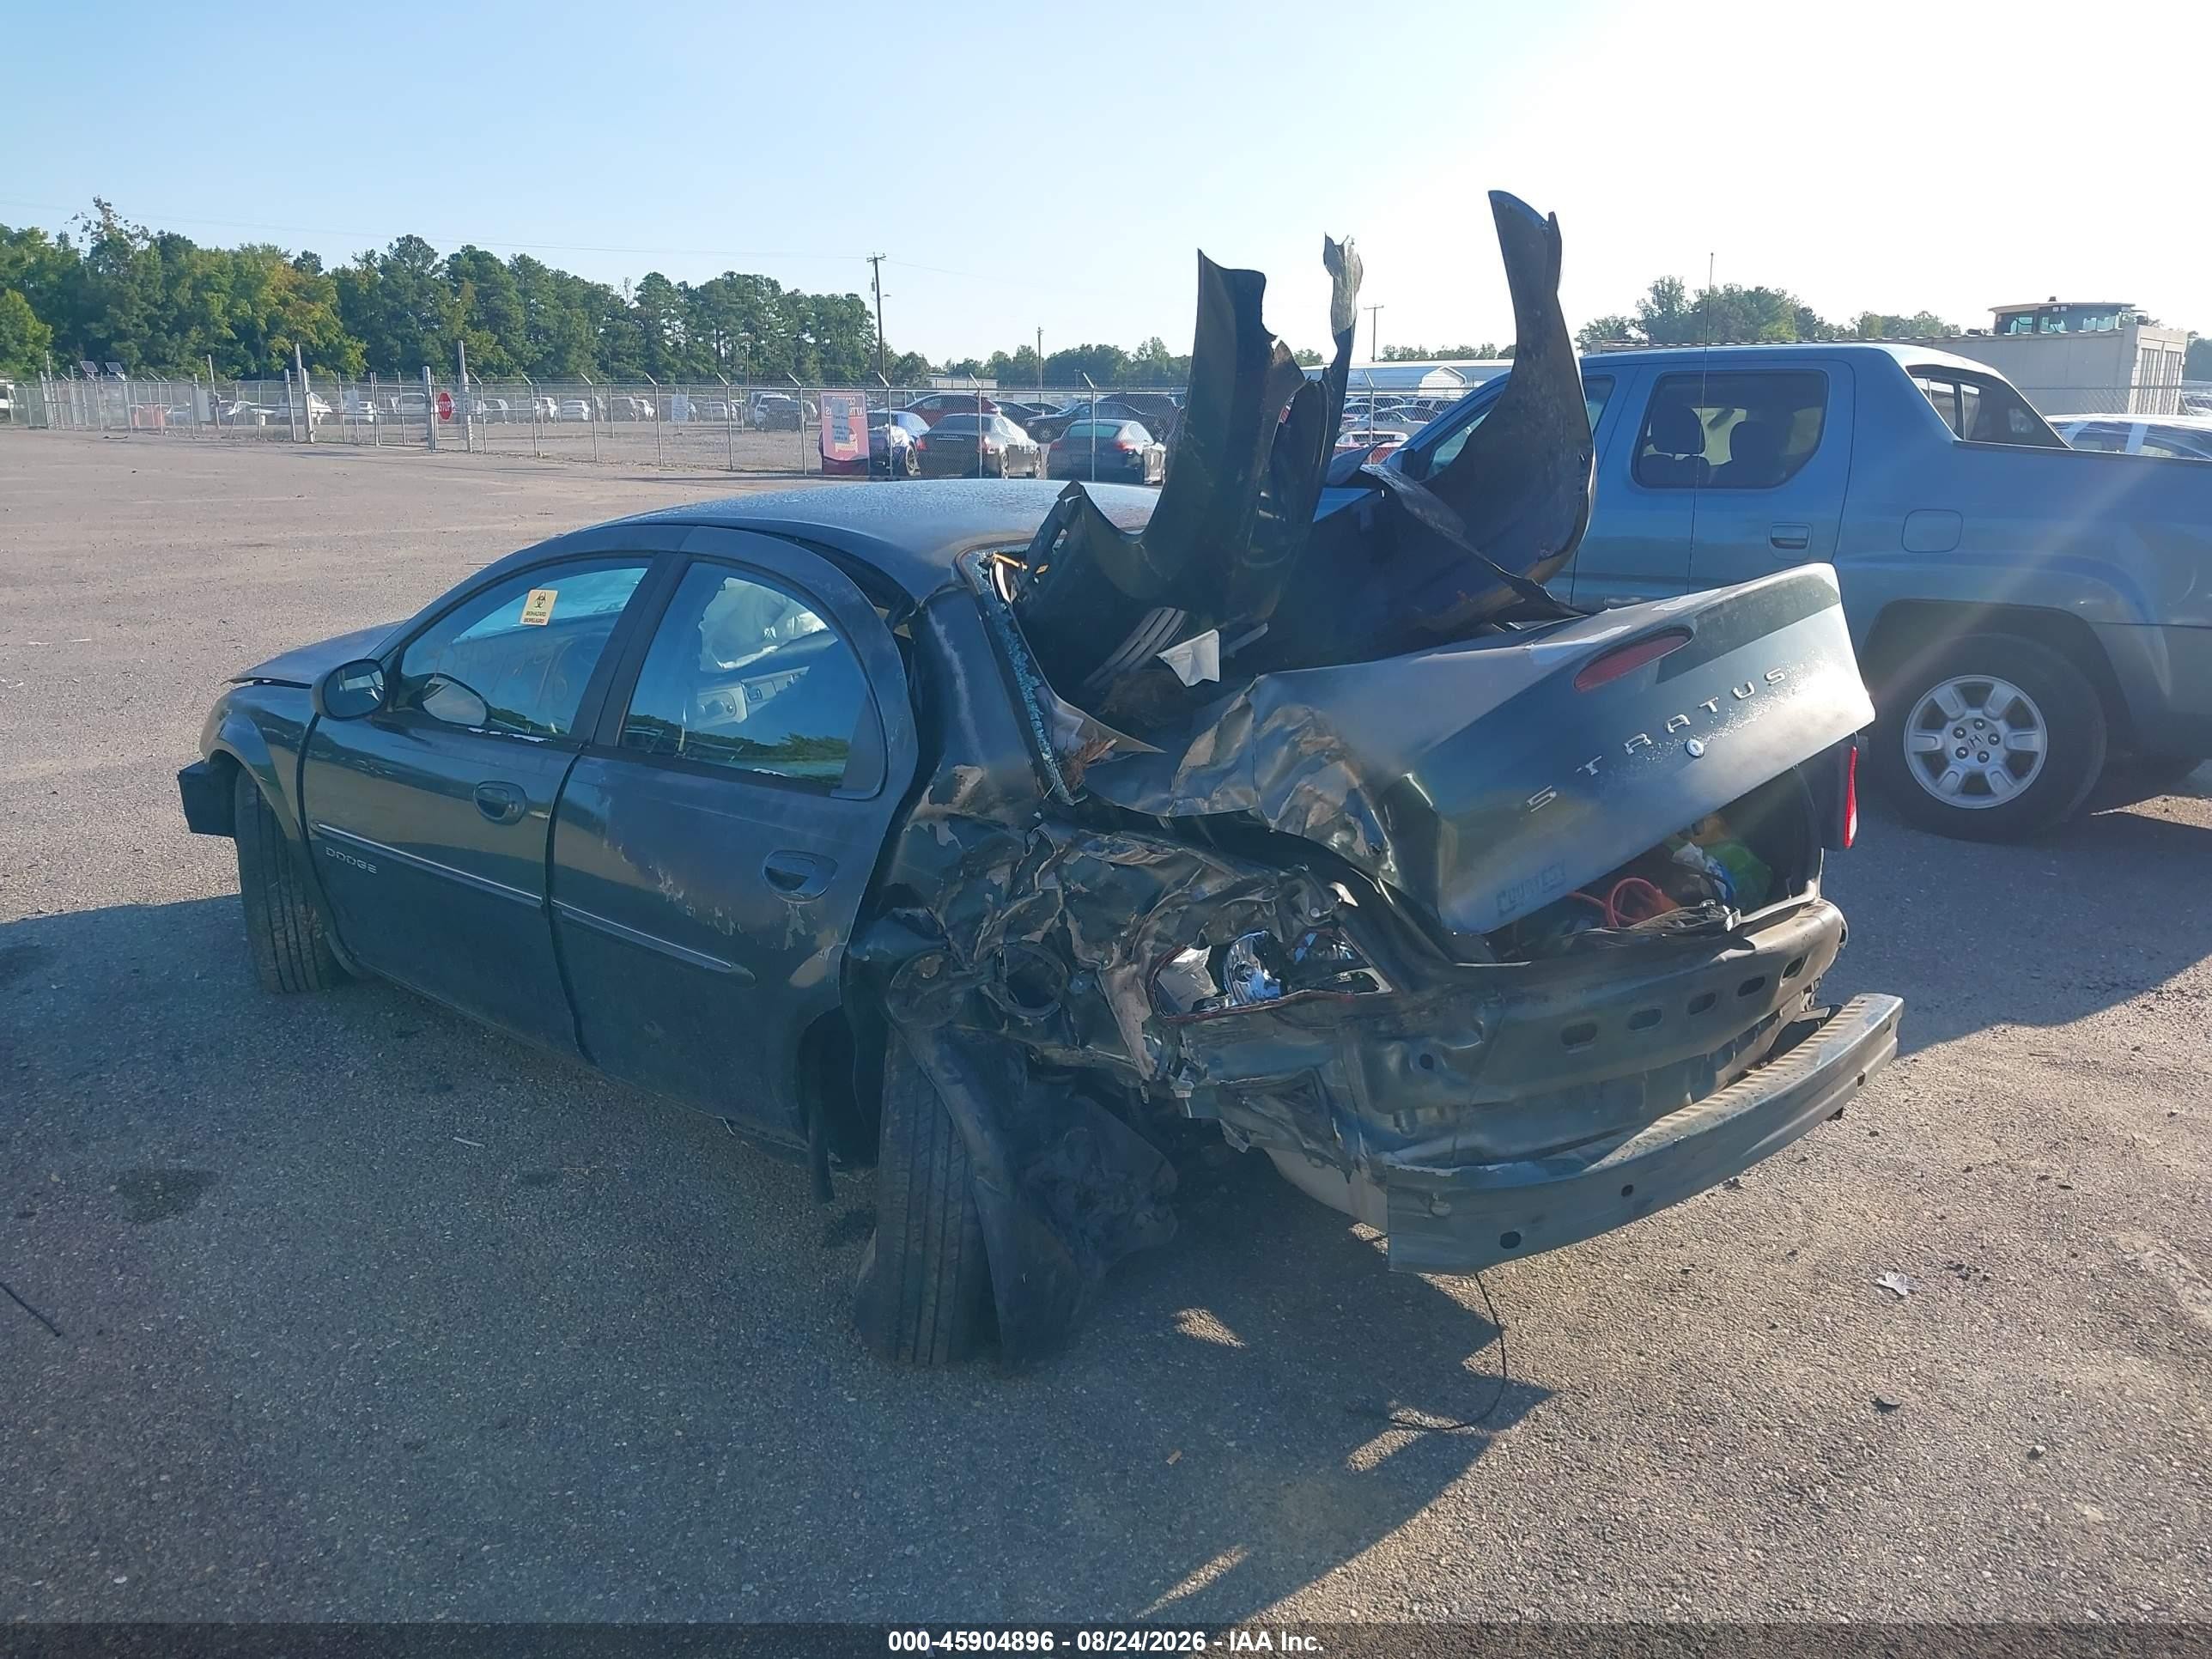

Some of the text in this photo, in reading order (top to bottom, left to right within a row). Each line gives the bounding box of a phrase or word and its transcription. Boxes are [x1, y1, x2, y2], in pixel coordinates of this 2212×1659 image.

[439, 401, 451, 412] STOP
[1526, 666, 1787, 813] STRATUS
[325, 847, 378, 874] DODGE
